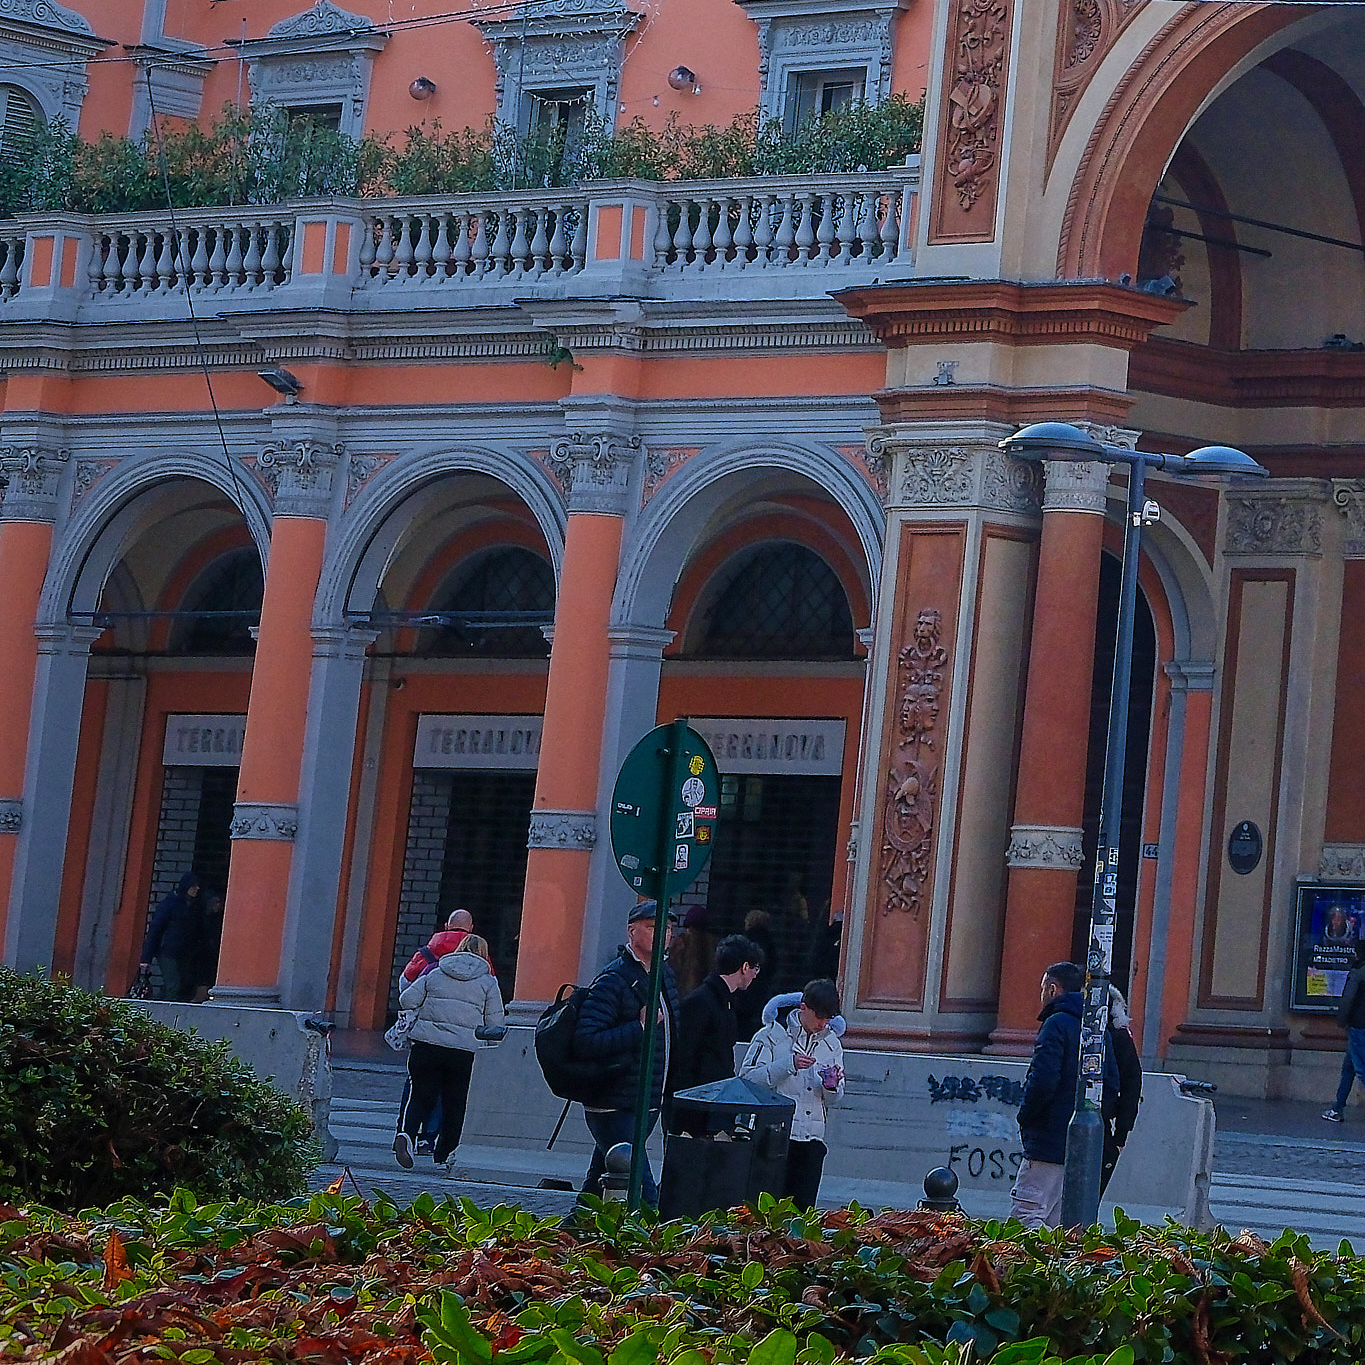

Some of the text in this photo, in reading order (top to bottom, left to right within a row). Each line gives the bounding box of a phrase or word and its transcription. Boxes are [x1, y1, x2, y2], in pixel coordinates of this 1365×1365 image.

[176, 727, 244, 753] TERRA
[430, 727, 540, 755] TERRANOV
[706, 731, 825, 761] ERRANOVA
